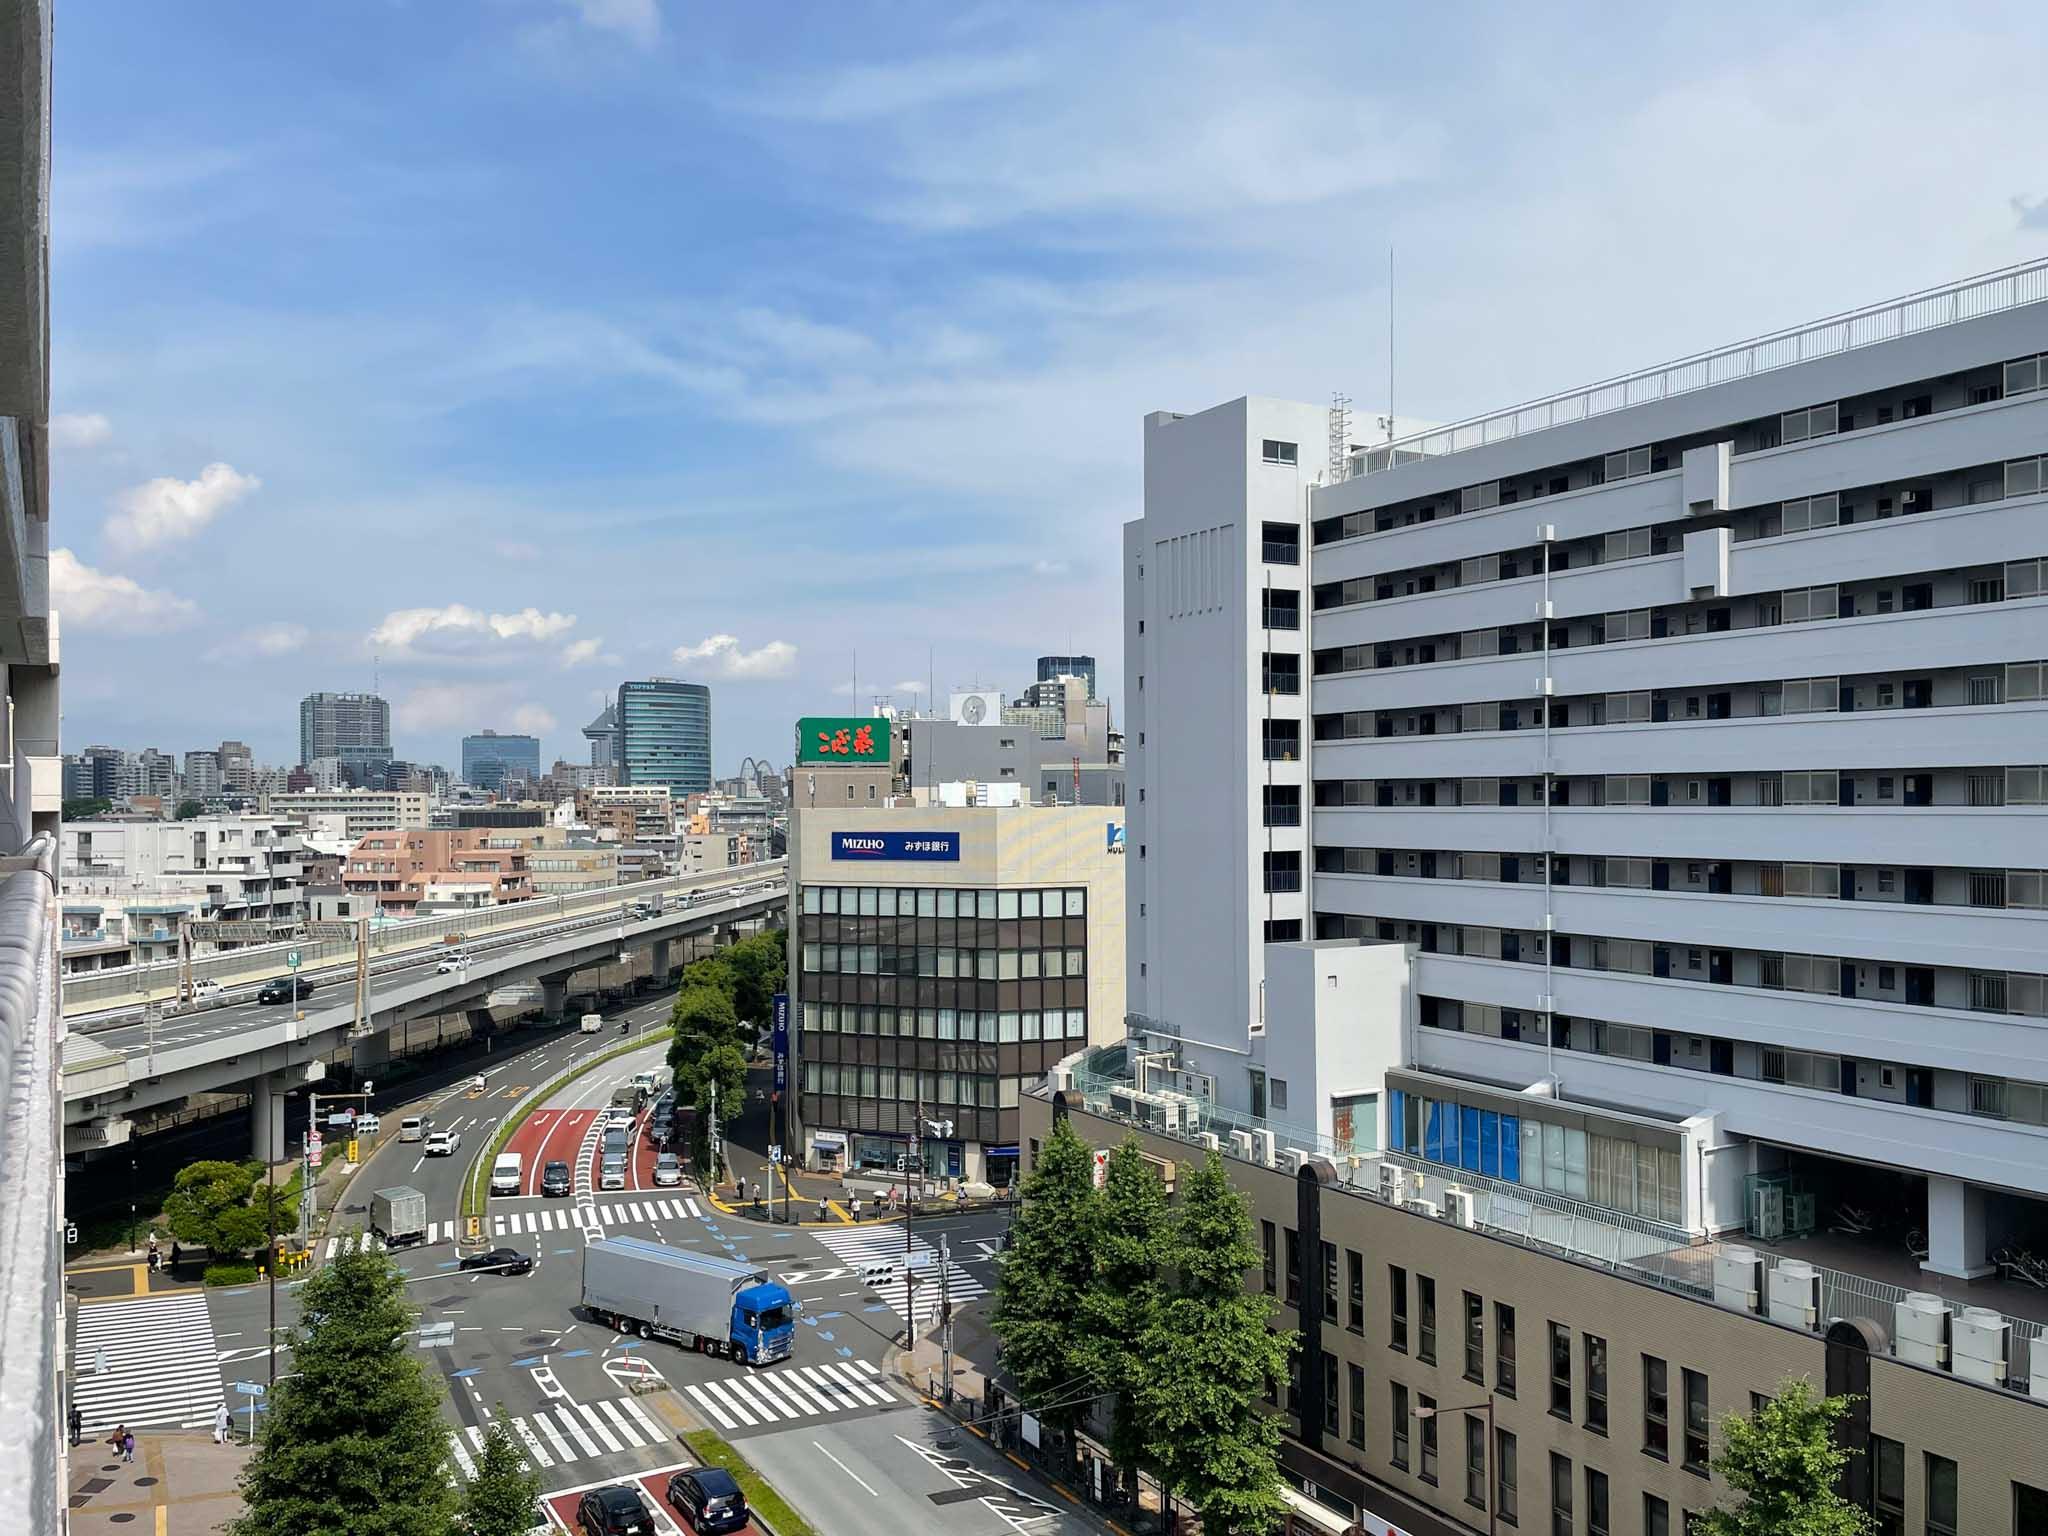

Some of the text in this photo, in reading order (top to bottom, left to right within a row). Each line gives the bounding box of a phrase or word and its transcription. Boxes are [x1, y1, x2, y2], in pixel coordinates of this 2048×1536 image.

[842, 838, 885, 849] MIZUHO
[904, 841, 949, 852] みずほ銀行
